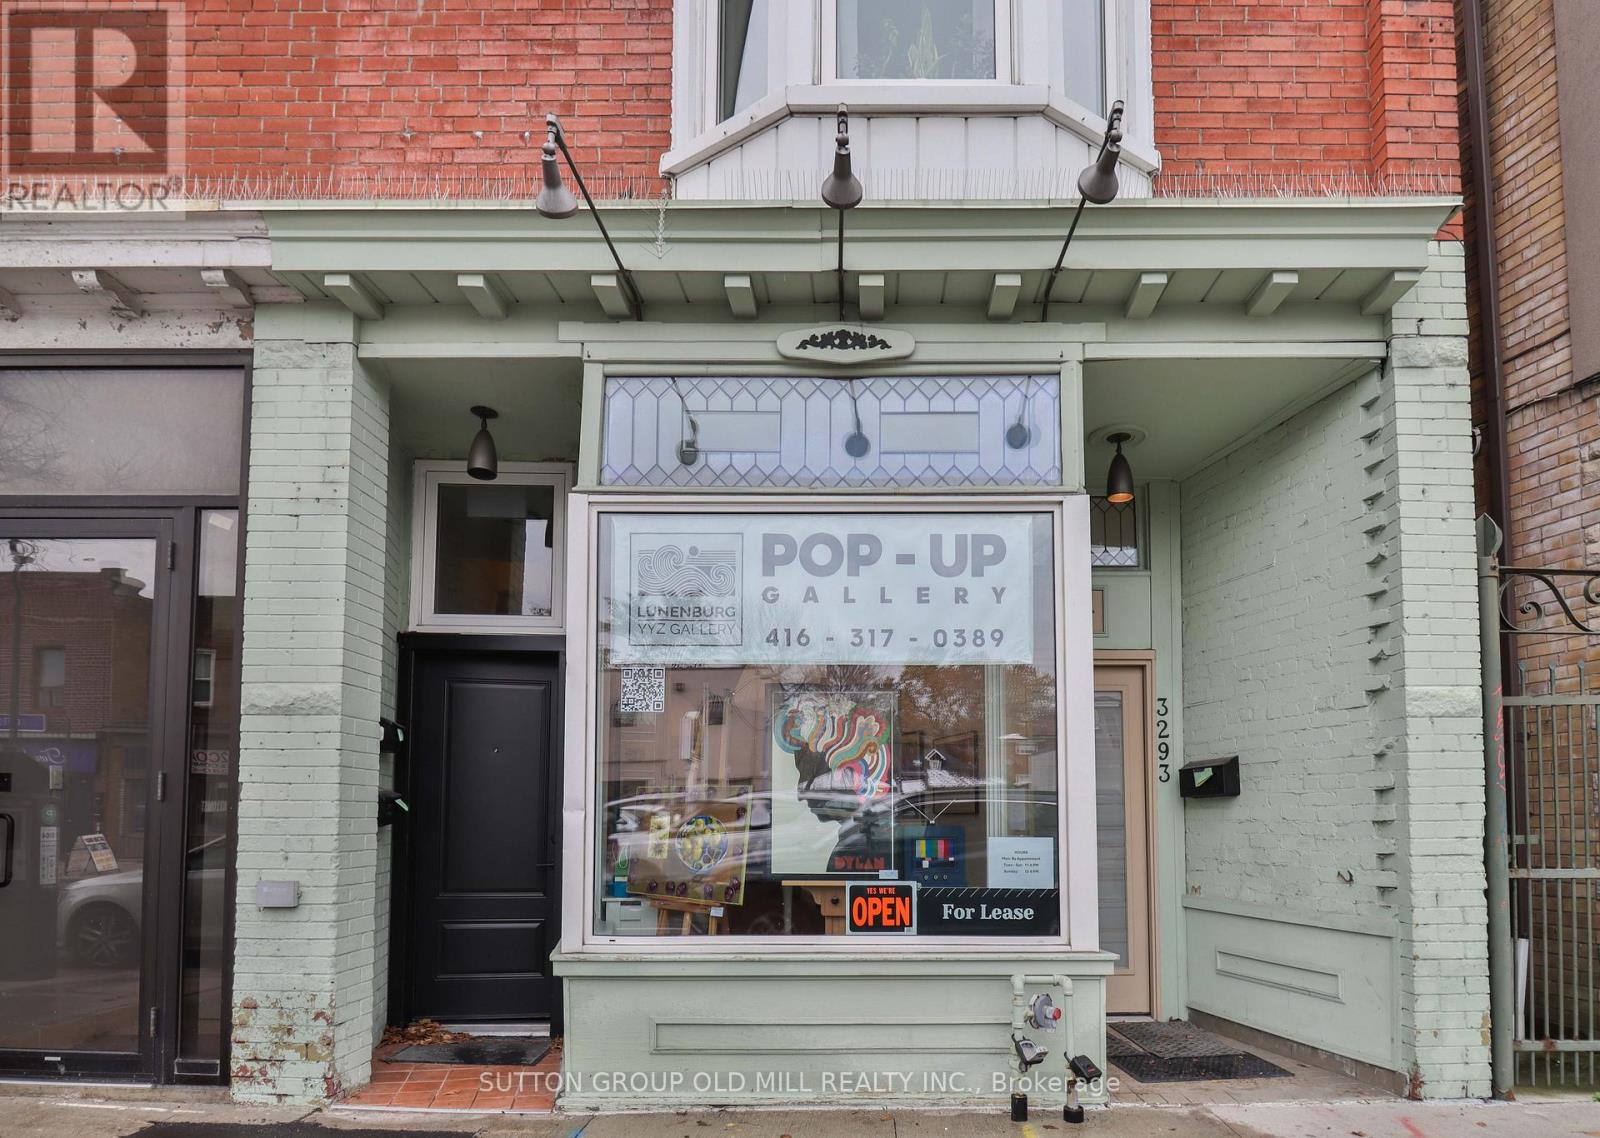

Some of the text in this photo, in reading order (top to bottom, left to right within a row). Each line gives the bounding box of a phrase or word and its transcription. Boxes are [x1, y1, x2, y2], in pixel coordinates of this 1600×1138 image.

[762, 586, 1006, 604] GALLERY
[638, 606, 736, 618] LUNENBURG
[637, 622, 735, 635] YYZ GALLERY
[1157, 697, 1170, 782] 3293
[834, 857, 885, 869] DYLAN
[866, 887, 896, 895] YES WE'RE
[852, 897, 910, 927] OPEN
[942, 903, 1034, 920] For Lease
